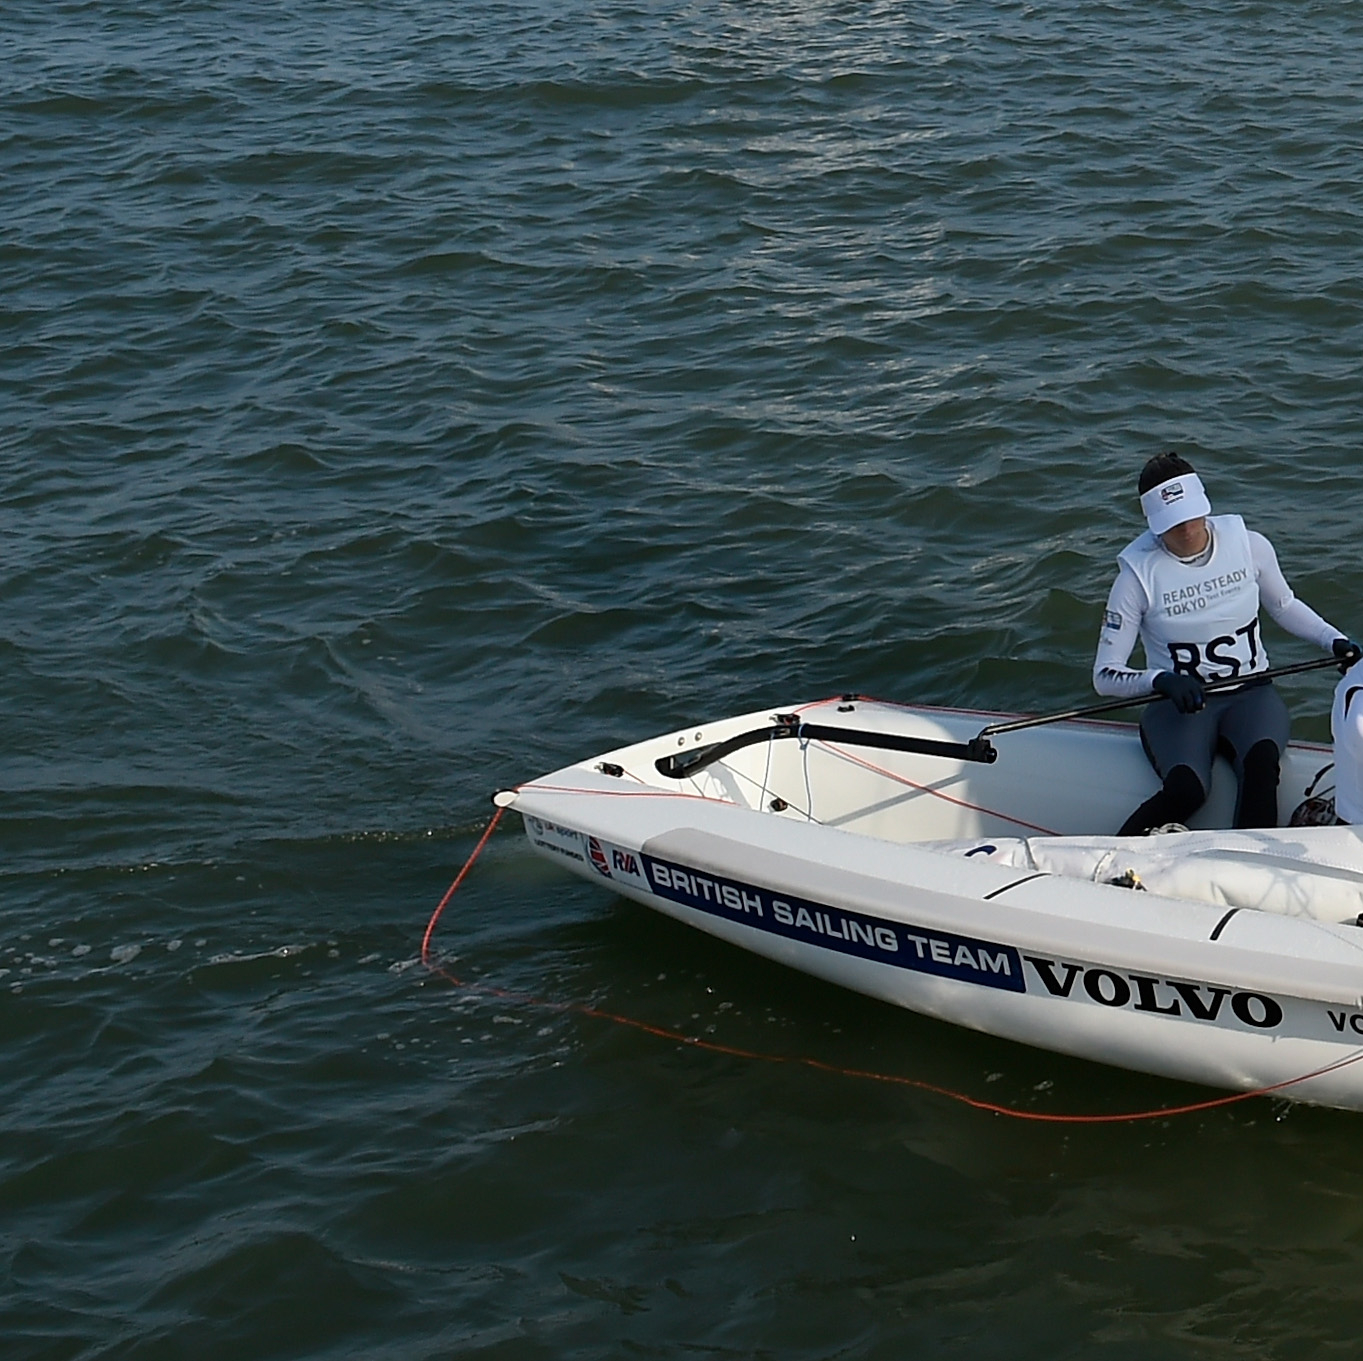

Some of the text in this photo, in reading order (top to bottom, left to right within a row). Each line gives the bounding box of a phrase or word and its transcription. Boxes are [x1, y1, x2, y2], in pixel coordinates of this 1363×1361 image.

[1163, 568, 1248, 605] READY STEADY
[1165, 597, 1206, 617] TOKYO
[1167, 617, 1258, 681] RST
[651, 862, 1011, 976] BRITISH SAILING TEAM
[1023, 955, 1284, 1029] VOLVO
